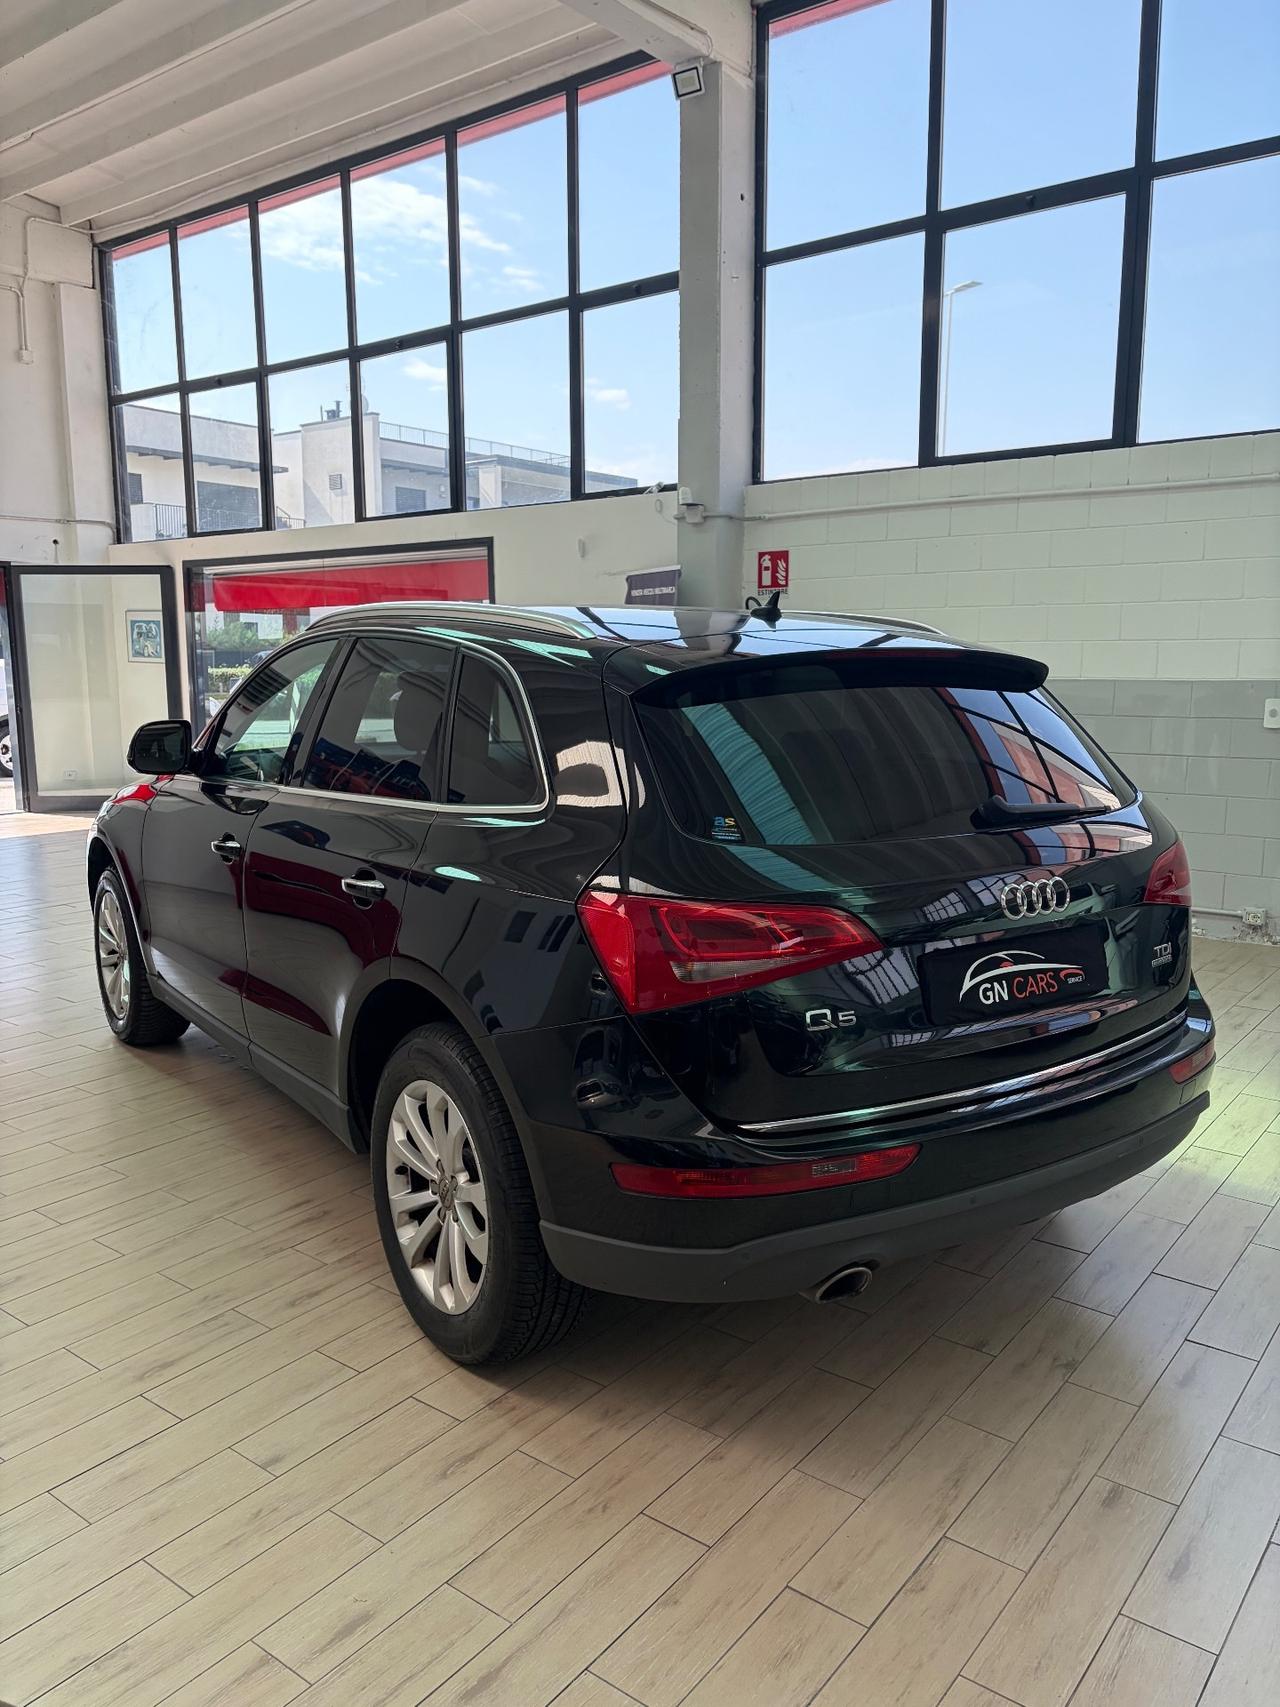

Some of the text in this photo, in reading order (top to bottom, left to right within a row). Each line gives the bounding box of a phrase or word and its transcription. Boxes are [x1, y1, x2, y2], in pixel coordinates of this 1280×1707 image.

[979, 980, 1009, 1005] GN
[1013, 972, 1058, 999] CARS
[805, 1008, 857, 1031] Q5
